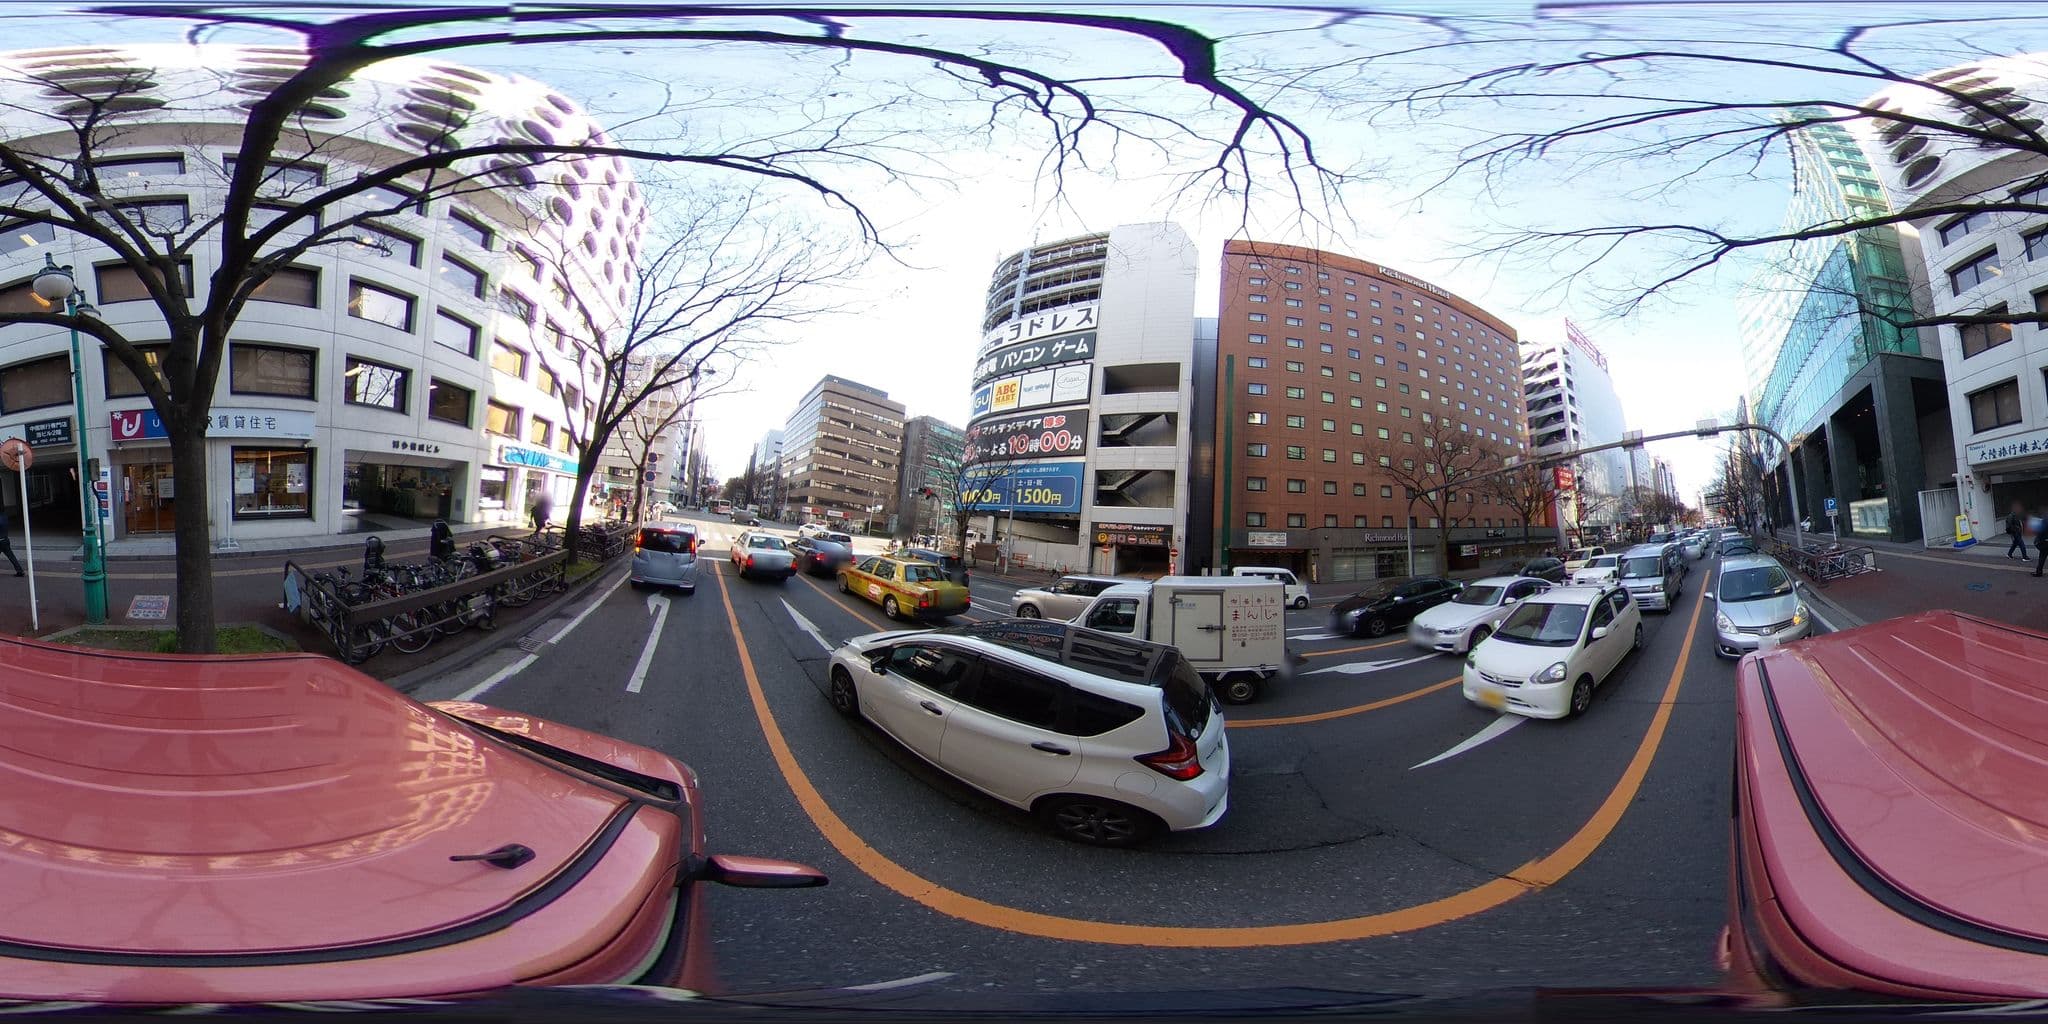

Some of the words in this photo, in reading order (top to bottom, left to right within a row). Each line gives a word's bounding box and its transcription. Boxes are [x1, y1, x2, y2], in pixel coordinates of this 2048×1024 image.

[1001, 346, 1046, 369] パソコン
[1052, 337, 1089, 358] ゲーム
[996, 383, 1017, 397] ABC
[974, 393, 989, 409] GU
[995, 394, 1016, 405] MART
[1016, 488, 1062, 505] 1500円
[1365, 533, 1396, 543] Richmond
